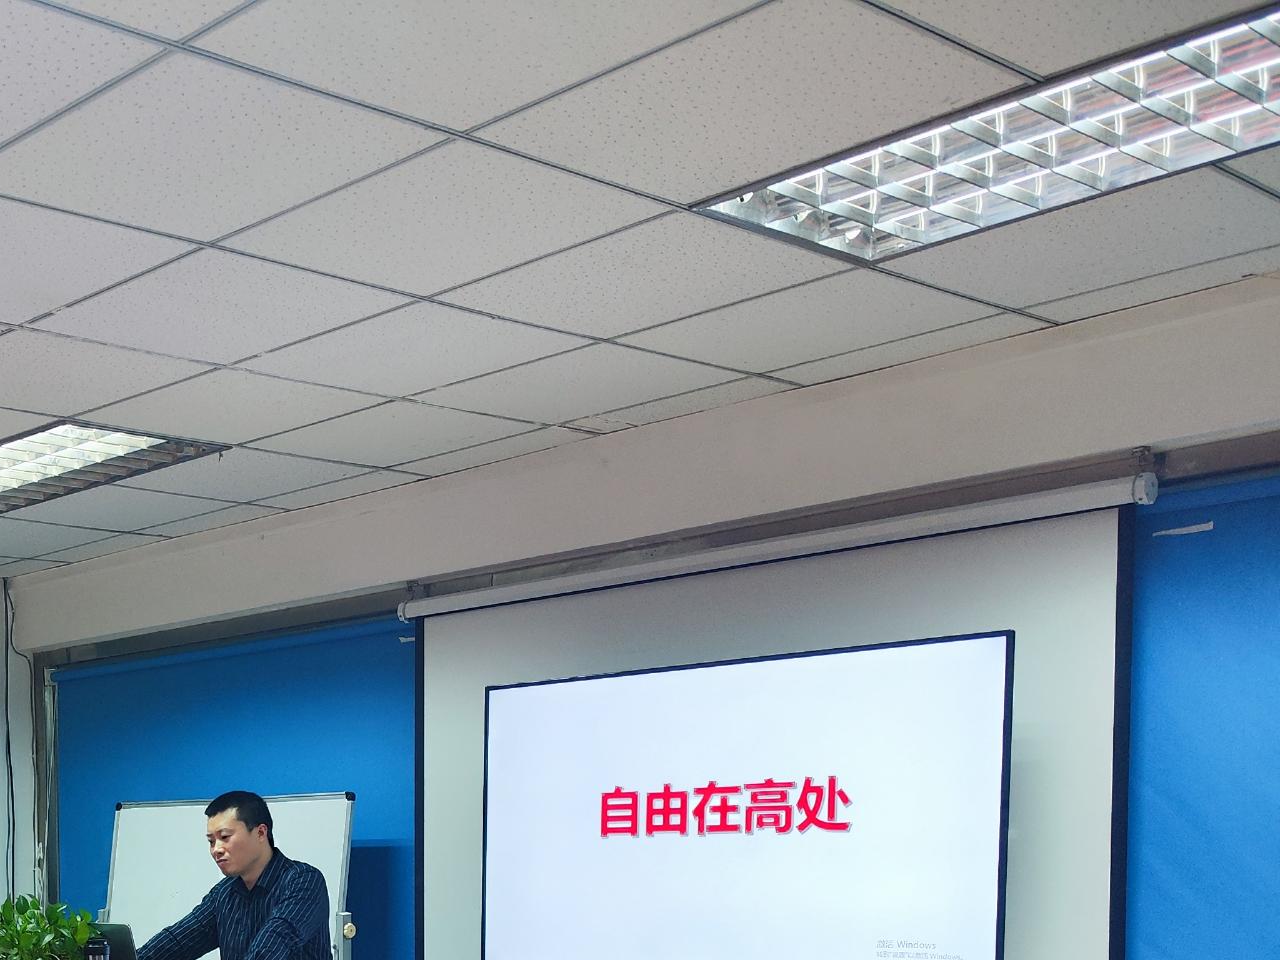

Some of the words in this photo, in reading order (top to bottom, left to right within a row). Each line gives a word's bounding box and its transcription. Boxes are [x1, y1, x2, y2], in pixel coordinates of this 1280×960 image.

[600, 775, 854, 838] 自由在高处
[897, 940, 936, 950] Windows
